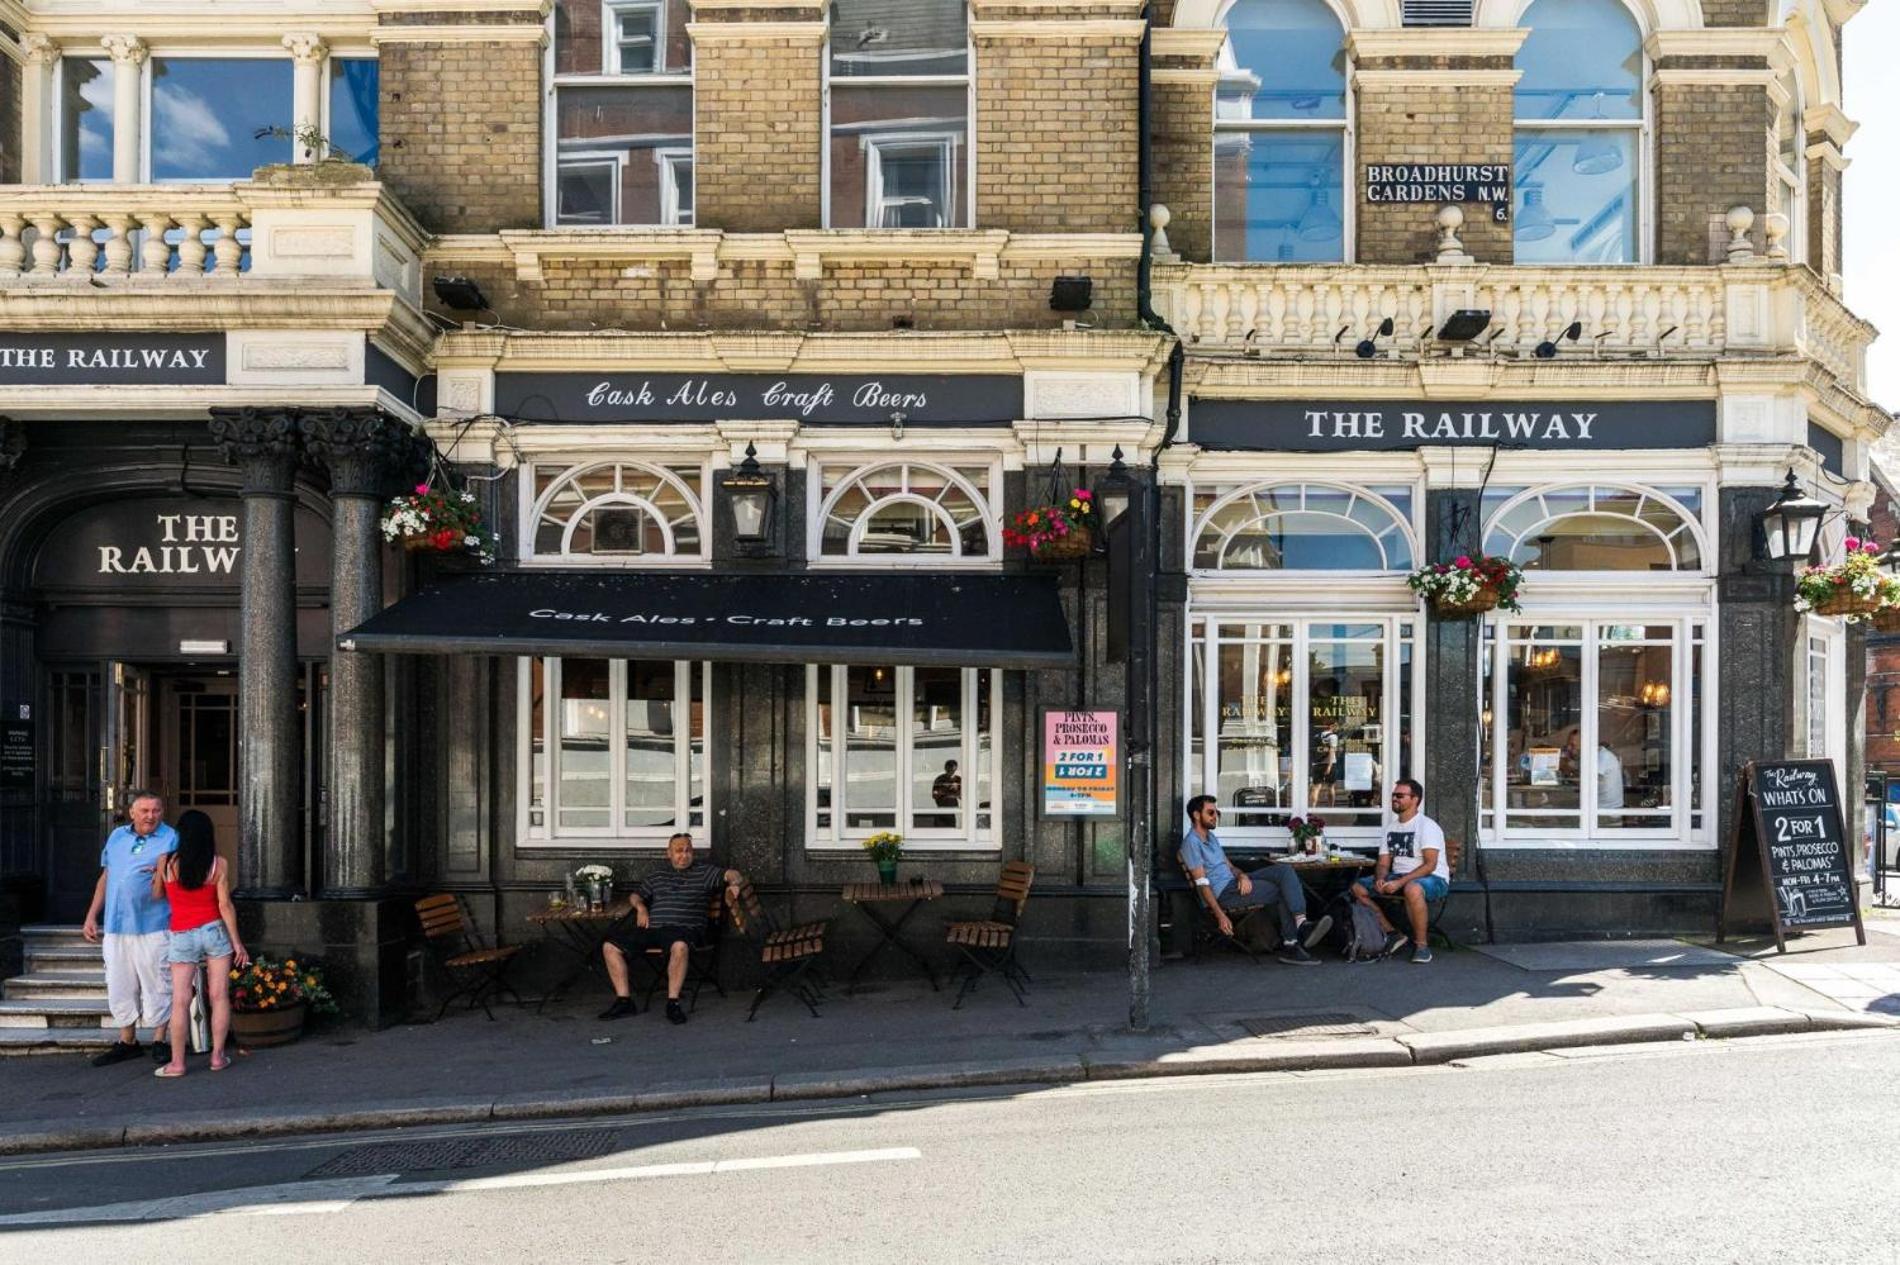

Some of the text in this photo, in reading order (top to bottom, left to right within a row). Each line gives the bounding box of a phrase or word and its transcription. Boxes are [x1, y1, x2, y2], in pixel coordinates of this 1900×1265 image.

[1368, 166, 1508, 182] BROADHURST
[1368, 185, 1508, 201] GARDENS N.W.
[0, 348, 209, 368] THE RAILWAY
[585, 380, 926, 416] Cask Ales Craft Beers
[1305, 410, 1598, 439] THE RAILWAY
[157, 515, 239, 542] THE
[98, 546, 241, 573] RAILW
[529, 609, 923, 626] Cask Ales Craft Beers
[1331, 696, 1360, 705] THE
[1064, 712, 1097, 723] PINTS,
[1313, 707, 1376, 716] RAILWAY
[1055, 723, 1107, 733] PROSECCO
[1054, 735, 1109, 745] & PALOMAS
[1059, 753, 1102, 761] 2 FOR 1
[1775, 768, 1817, 787] Railway
[1763, 788, 1826, 806] WHAT'S ON
[1775, 815, 1826, 842] 2 FOR 1
[1797, 842, 1838, 856] PROSECCO
